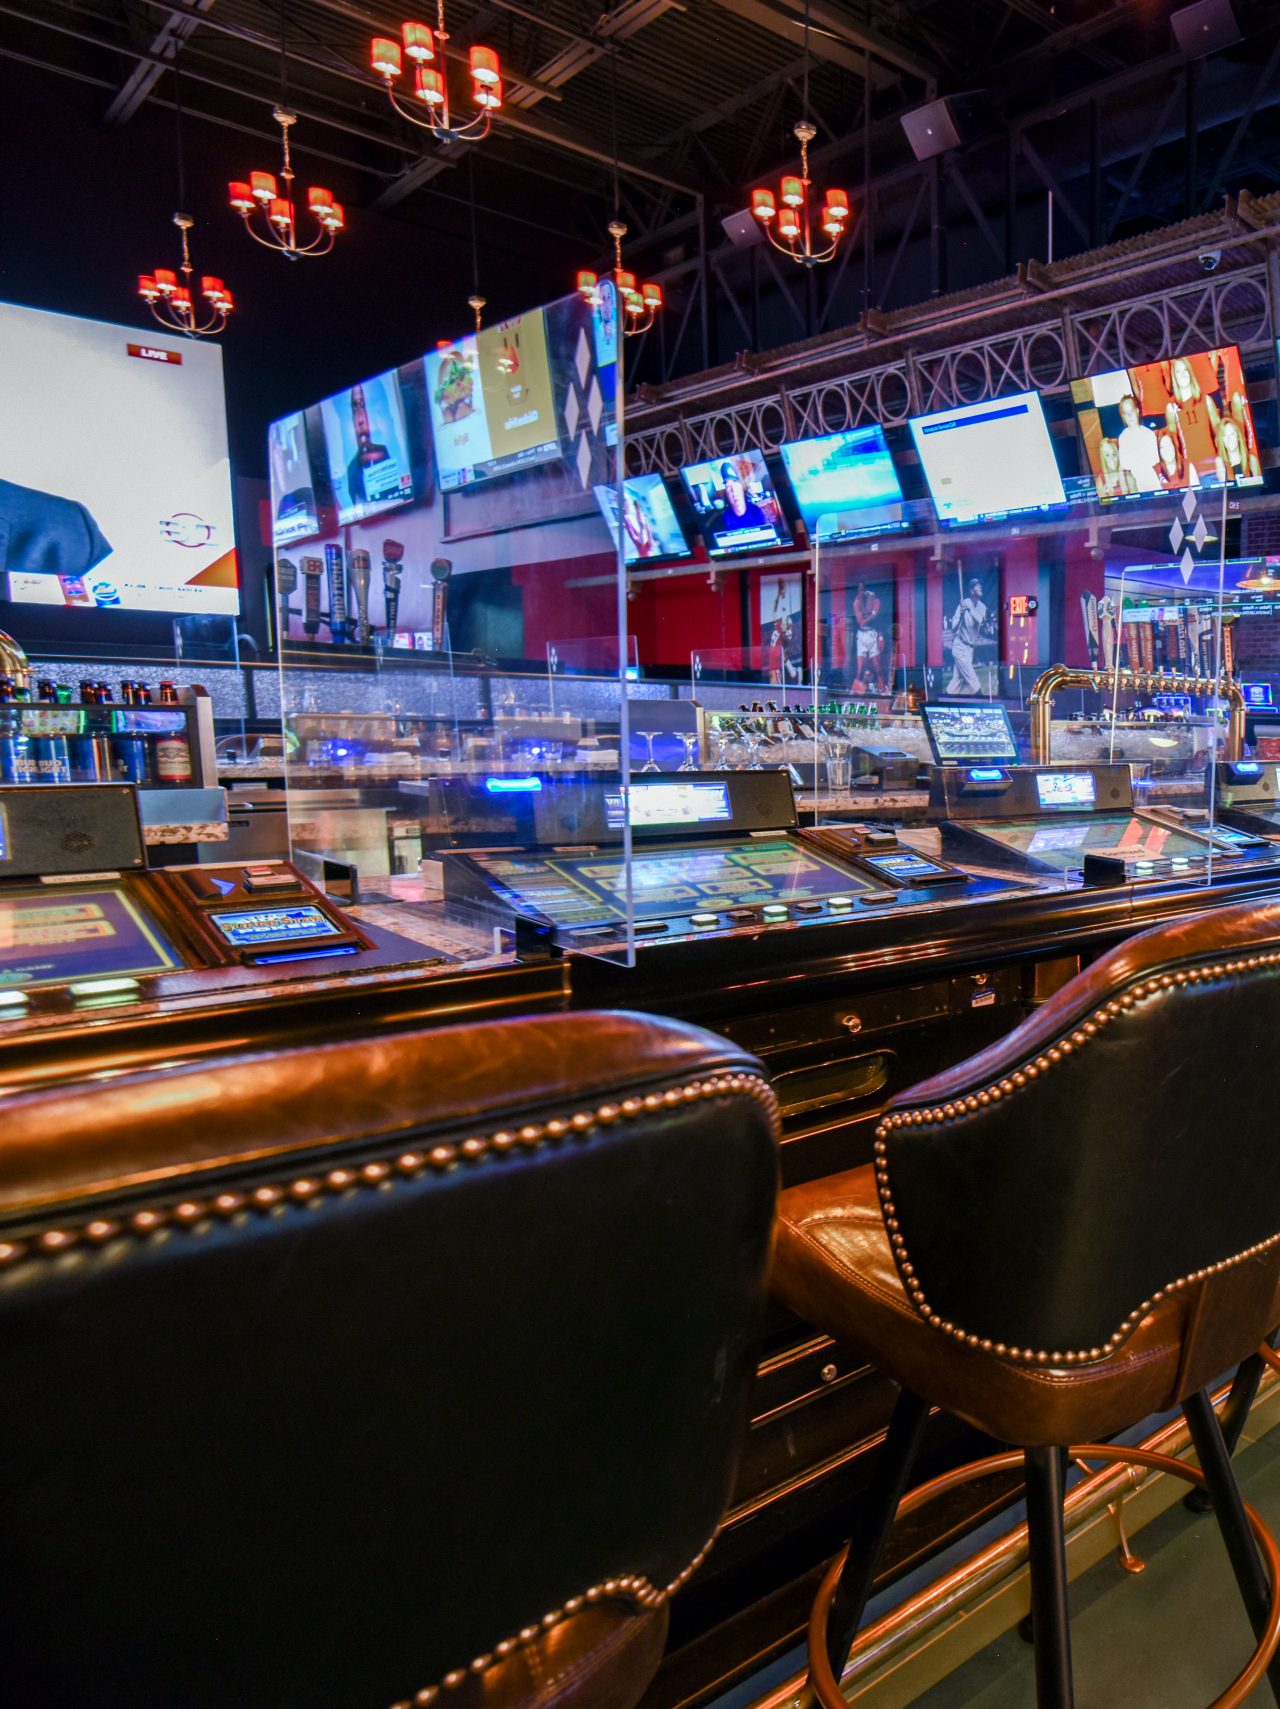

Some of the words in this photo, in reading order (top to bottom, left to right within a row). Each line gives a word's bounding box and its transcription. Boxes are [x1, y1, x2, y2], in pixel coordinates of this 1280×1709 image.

[140, 348, 168, 361] LIVE
[1010, 597, 1026, 614] EXIT
[1178, 640, 1186, 658] BUD
[221, 919, 279, 931] SUPER
[281, 915, 324, 926] STAR
